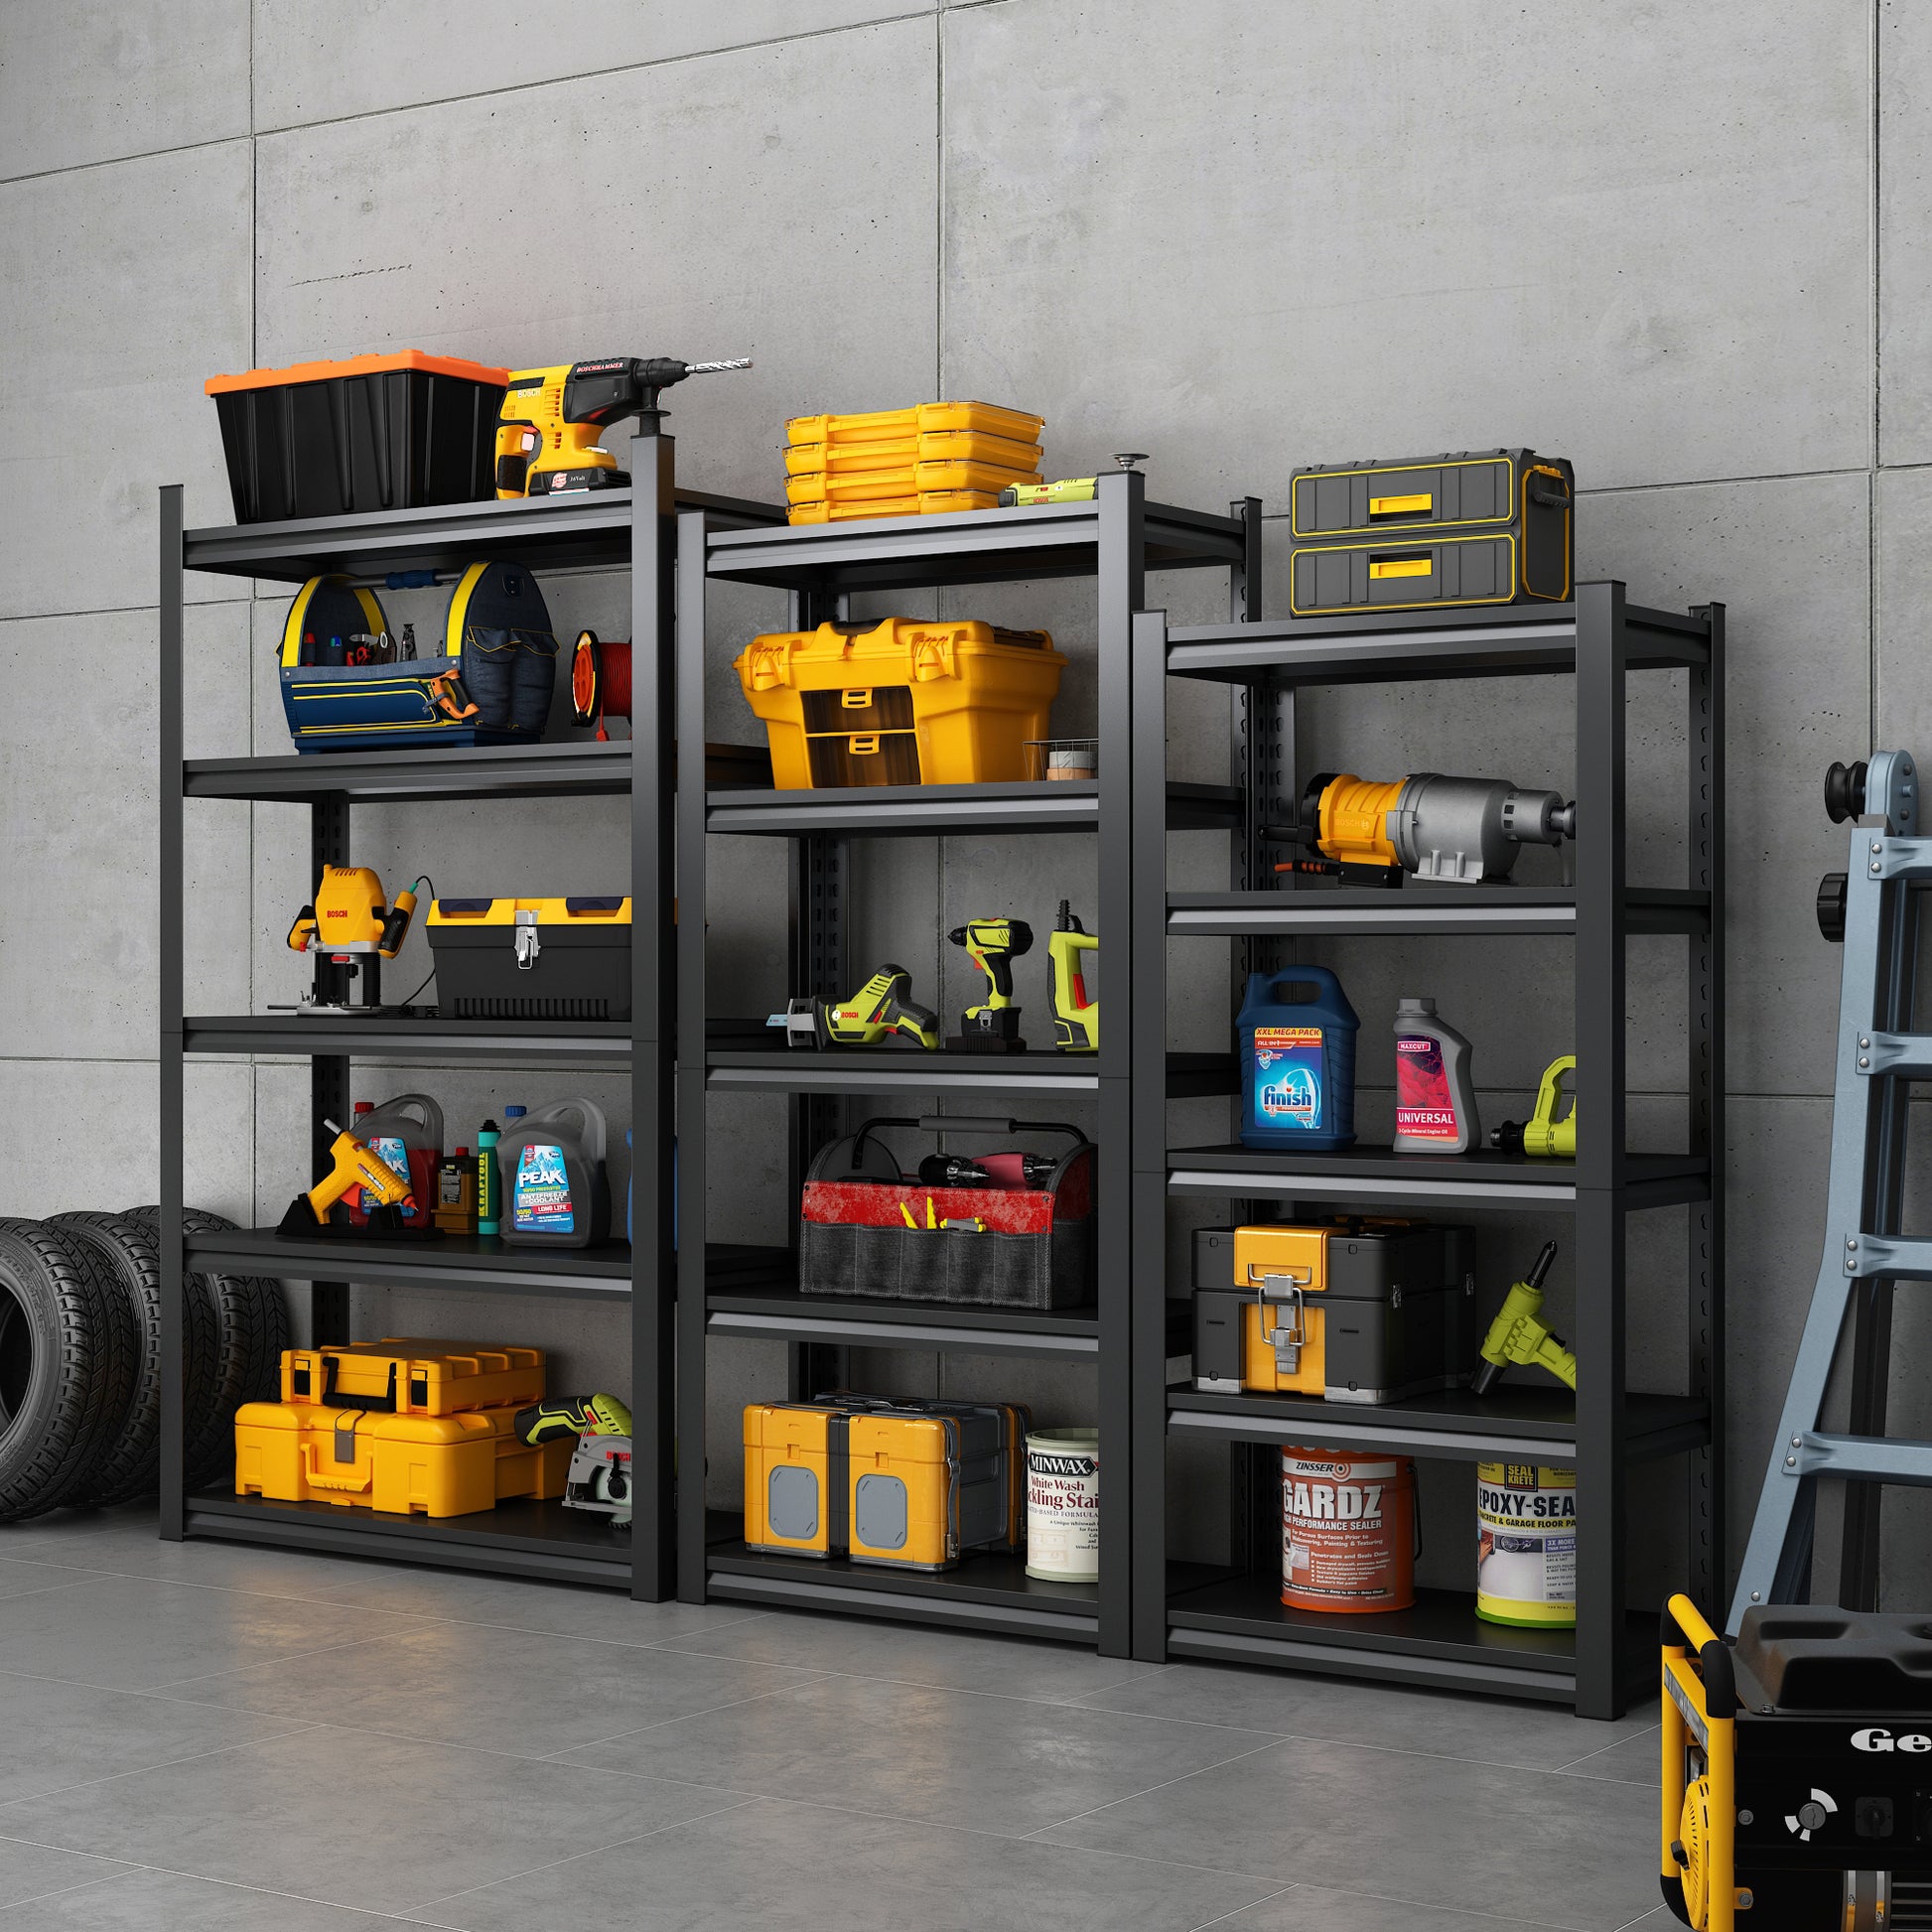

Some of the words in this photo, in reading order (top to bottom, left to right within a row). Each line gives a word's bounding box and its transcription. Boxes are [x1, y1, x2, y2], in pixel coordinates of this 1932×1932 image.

[517, 388, 541, 398] BOSCH
[327, 909, 348, 918] BOSCH
[1264, 1085, 1311, 1106] finish
[1398, 1112, 1454, 1124] UNIVERSAL
[518, 1170, 567, 1188] PEAK
[1031, 1453, 1089, 1474] MINWAX
[1296, 1461, 1334, 1472] ZINSSER
[1508, 1464, 1534, 1476] SEAL
[1031, 1475, 1053, 1489] White
[1054, 1479, 1085, 1491] Wash
[1508, 1475, 1534, 1485] KRETE
[1028, 1488, 1063, 1510] ckling
[1066, 1491, 1098, 1509] Stai
[1283, 1478, 1382, 1520] GARDZ
[1478, 1487, 1576, 1517] EPOXY-SEA
[1292, 1516, 1348, 1531] PERFORMANCE
[1350, 1519, 1382, 1530] SEALER
[1505, 1518, 1536, 1528] GARAGE
[1311, 1551, 1342, 1560] Penetrates
[1850, 1728, 1932, 1753] Ge
